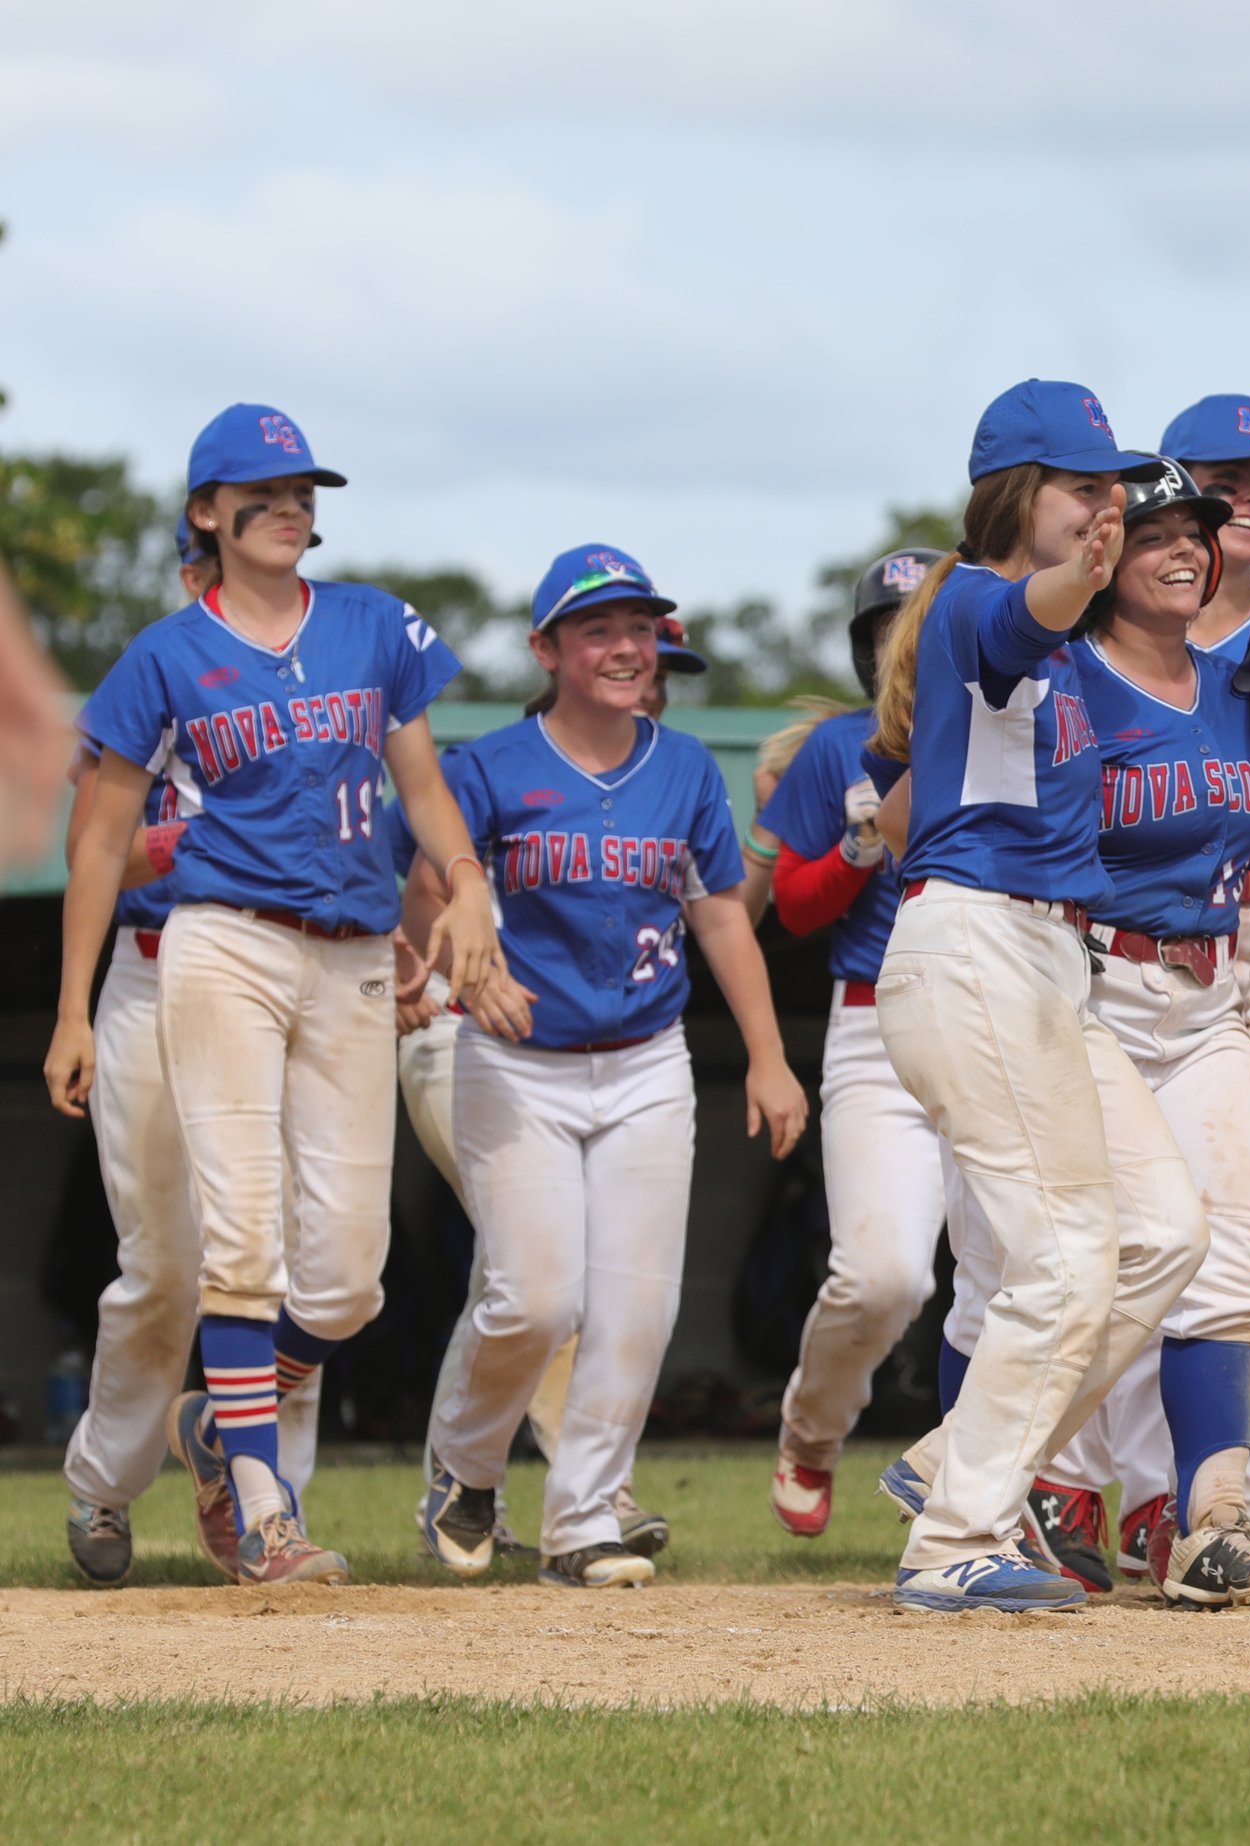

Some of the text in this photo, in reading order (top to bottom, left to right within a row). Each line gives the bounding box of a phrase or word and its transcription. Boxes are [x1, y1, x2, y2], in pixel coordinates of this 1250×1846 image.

[186, 701, 289, 787] NOVA
[1099, 760, 1197, 832] NOVA
[502, 831, 593, 896] NOVA
